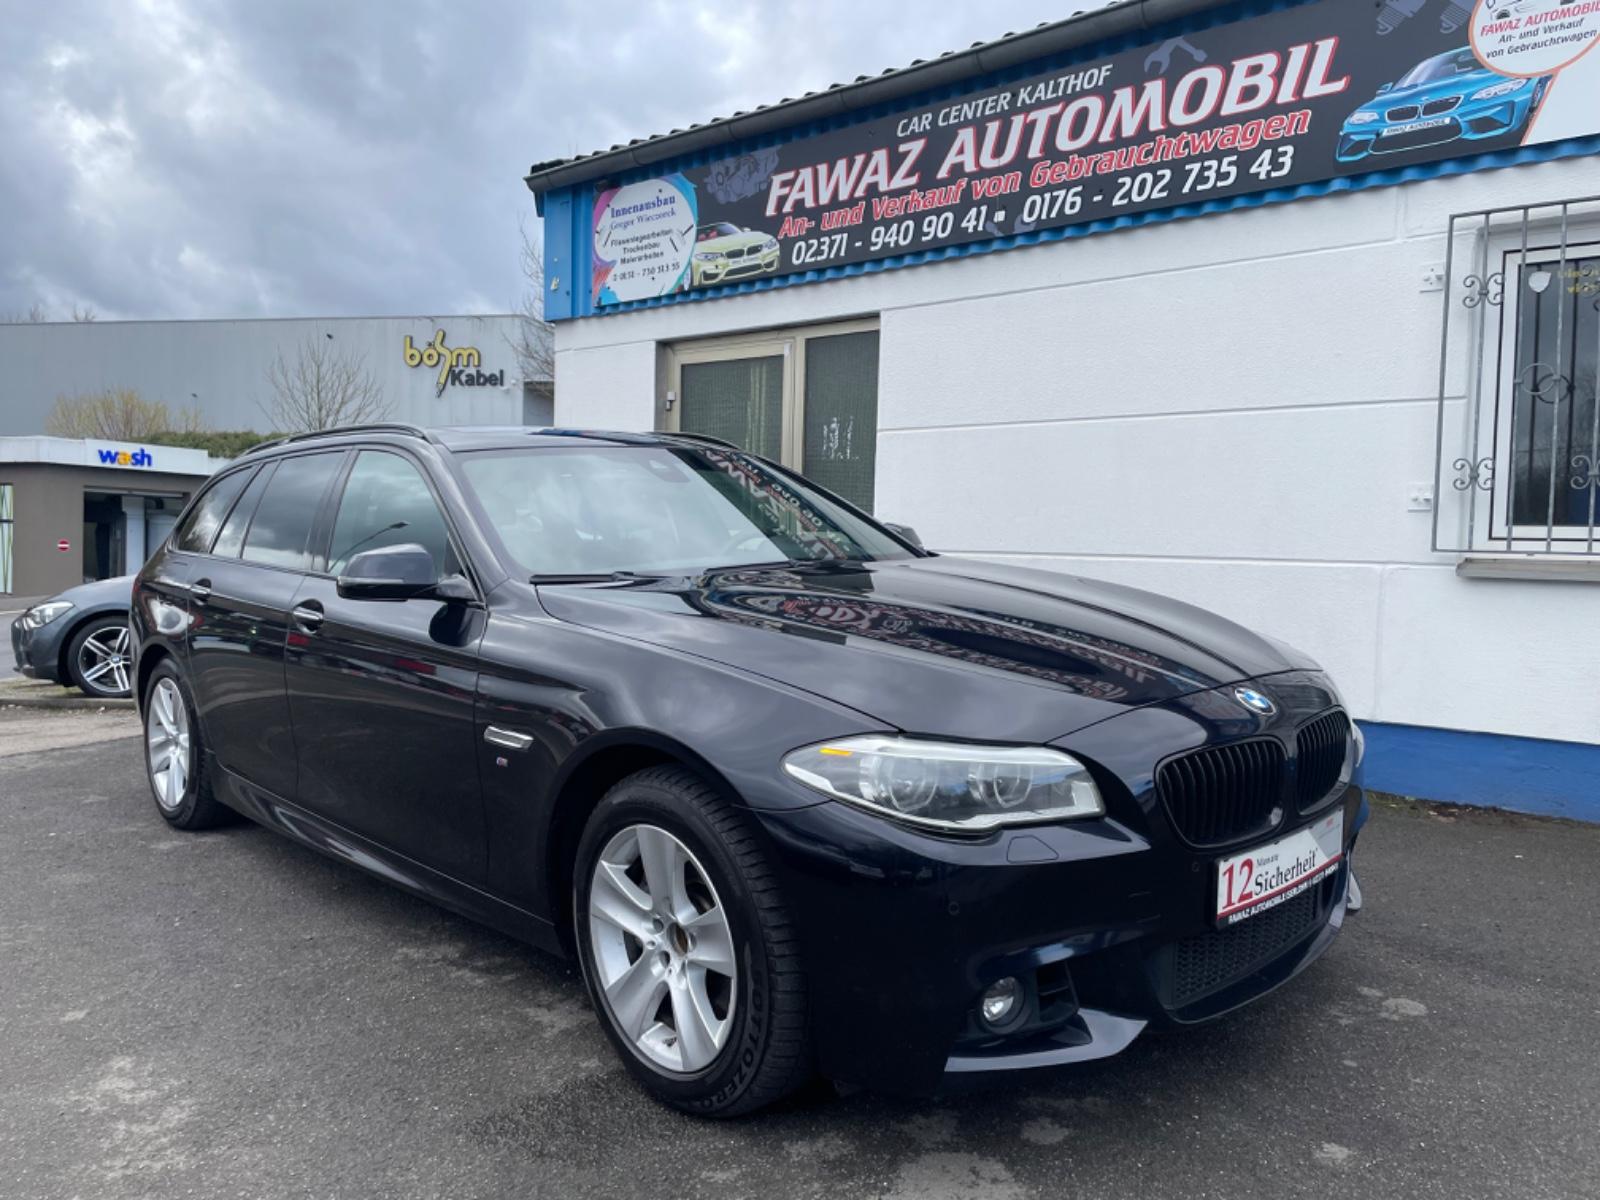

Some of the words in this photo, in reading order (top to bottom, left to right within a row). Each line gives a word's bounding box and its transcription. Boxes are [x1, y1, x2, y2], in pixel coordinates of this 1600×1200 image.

[1480, 18, 1521, 37] FAWAZ
[1486, 48, 1504, 59] von
[1507, 29, 1598, 55] Gebrauchtwagen
[1498, 34, 1516, 44] An-
[1519, 28, 1540, 40] und
[1543, 17, 1585, 35] Verkauf
[896, 114, 931, 137] CAR
[937, 92, 1011, 126] CENTER
[1016, 64, 1113, 107] KALTHOF
[765, 138, 927, 217] FAWAZ
[936, 36, 1350, 179] AUTOMOBIL
[778, 215, 815, 240] An-
[820, 201, 864, 231] und
[871, 177, 968, 221] Verkauf
[972, 170, 1021, 200] von
[1029, 109, 1312, 188] Gebrauchtwagen
[1023, 186, 1083, 223] 0176
[1112, 168, 1172, 207] 202
[1182, 155, 1238, 194] 735
[1249, 145, 1294, 180] 43
[611, 195, 676, 218] Innenausbau
[791, 233, 848, 265] 02371
[870, 220, 914, 251] 940
[921, 212, 954, 242] 90
[961, 205, 988, 231] 41
[450, 369, 504, 386] Kabel
[98, 447, 152, 466] wash
[1222, 858, 1253, 909] 12
[1254, 848, 1316, 896] Sicherheit
